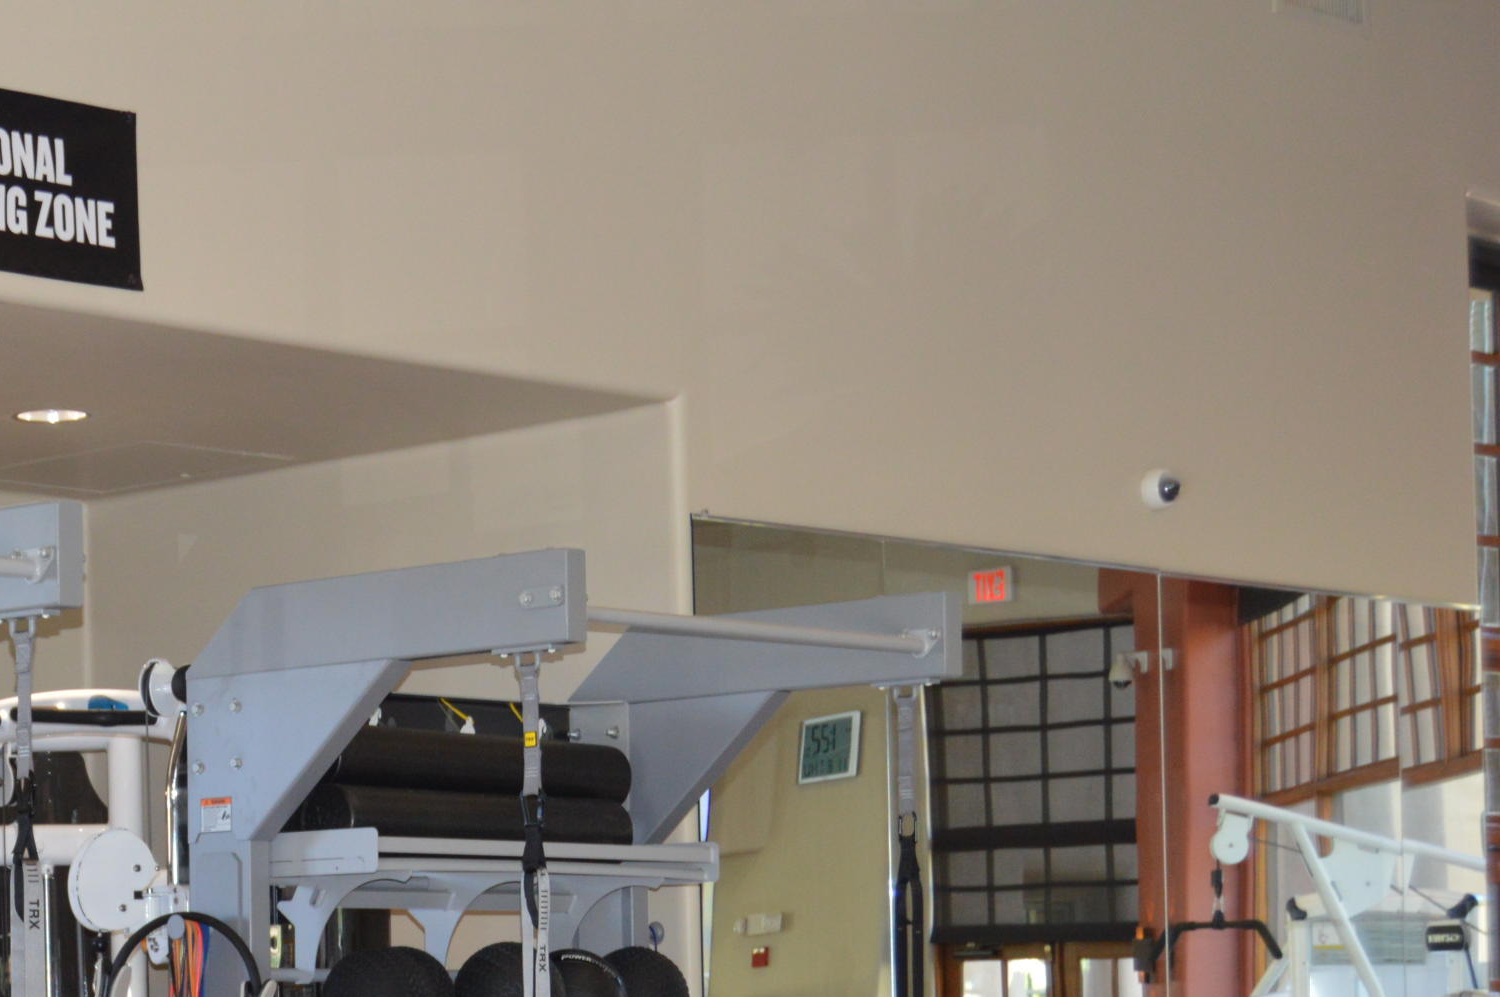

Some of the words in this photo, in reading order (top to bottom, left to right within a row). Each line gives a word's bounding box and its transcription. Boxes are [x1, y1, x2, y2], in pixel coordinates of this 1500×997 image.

[34, 189, 116, 248] ZONE
[29, 899, 40, 930] TRX
[539, 945, 547, 972] TRX
